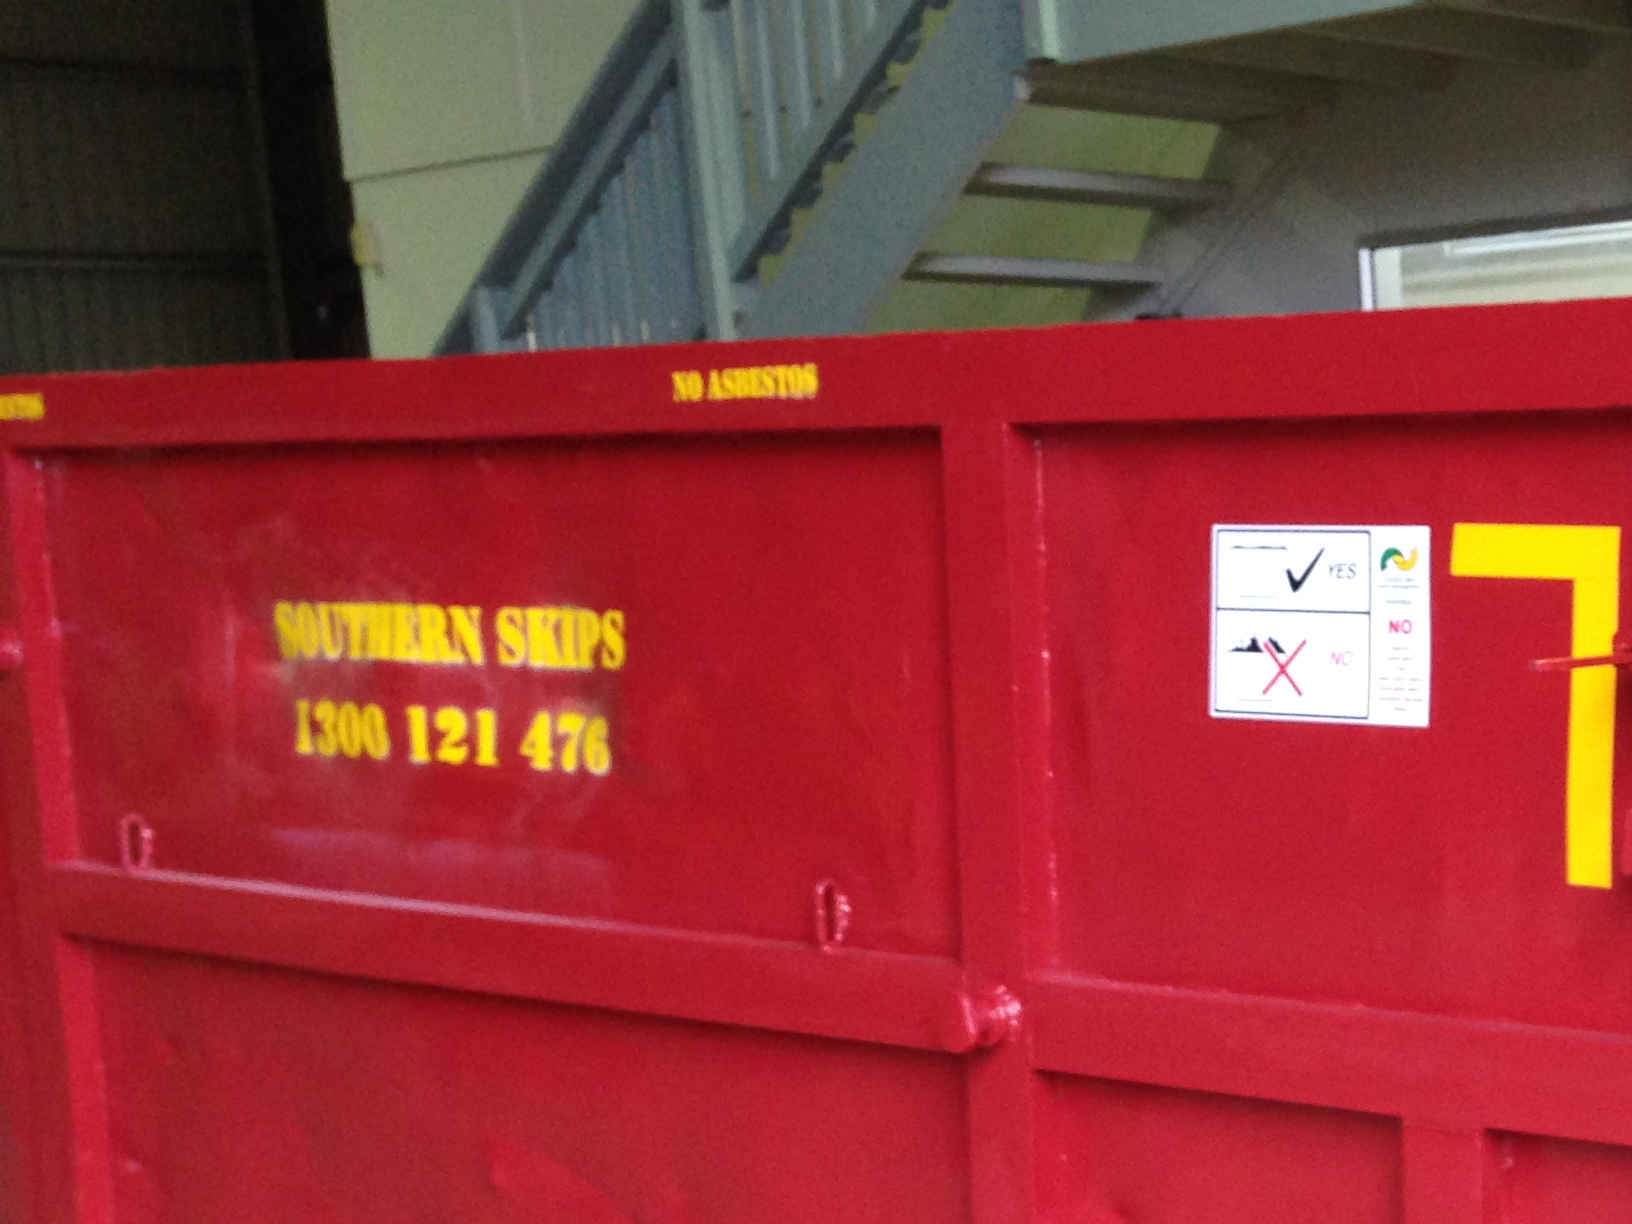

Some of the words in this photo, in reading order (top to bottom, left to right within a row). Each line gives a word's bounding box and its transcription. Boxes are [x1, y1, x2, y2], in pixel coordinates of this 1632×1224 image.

[671, 370, 704, 401] NO
[709, 362, 819, 400] ASBESTOS
[1328, 563, 1357, 579] YES
[274, 601, 484, 667] SOUTHERN
[495, 605, 626, 672] SKIPS
[1388, 619, 1412, 634] NO
[1330, 651, 1353, 666] NO
[296, 698, 390, 760] 1300
[405, 704, 498, 767] 121
[519, 710, 612, 776] 476
